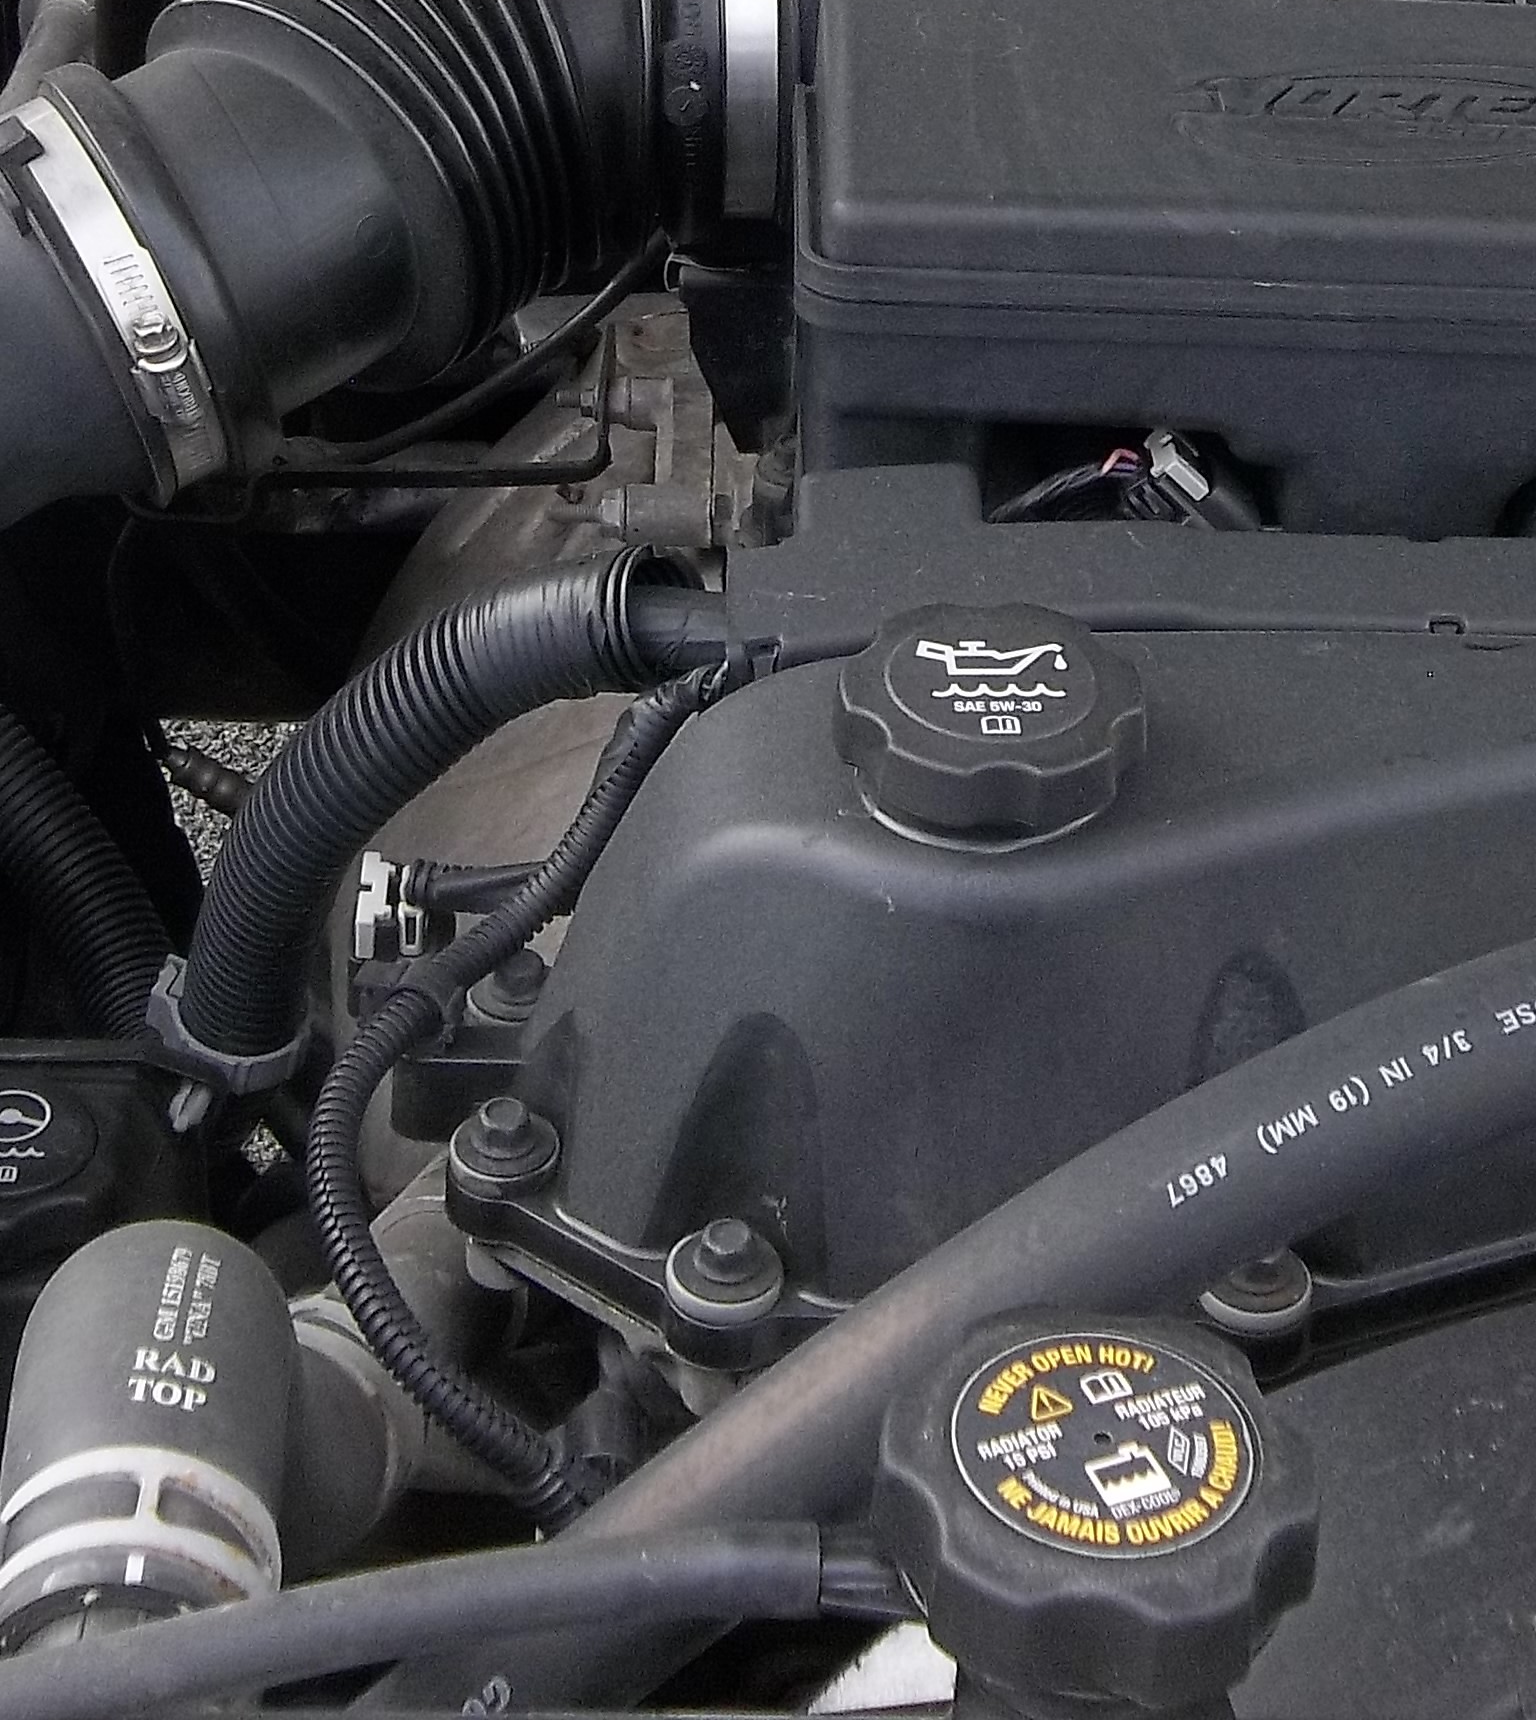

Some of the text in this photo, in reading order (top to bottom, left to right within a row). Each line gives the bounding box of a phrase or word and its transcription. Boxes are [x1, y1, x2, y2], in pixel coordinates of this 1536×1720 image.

[953, 700, 1043, 712] SAE 5W-30
[1421, 1029, 1473, 1067] 3/4
[1377, 1056, 1414, 1088] IN
[1328, 1076, 1371, 1112] (19
[1256, 1104, 1320, 1155] MM)
[1166, 1153, 1229, 1209] 4867
[132, 1346, 216, 1383] RAD
[977, 1343, 1156, 1415] NEVER OPEN HOT!
[128, 1376, 207, 1412] TOP
[1113, 1382, 1206, 1420] RADIATEUR
[1138, 1410, 1171, 1431] 105
[976, 1421, 1063, 1461] RADIATOR
[1025, 1440, 1057, 1464] PSI
[997, 1475, 1033, 1511] NE
[1026, 1501, 1121, 1545] JAMAIS
[1125, 1498, 1210, 1545] OUVRIR
[1072, 1499, 1099, 1519] USA
